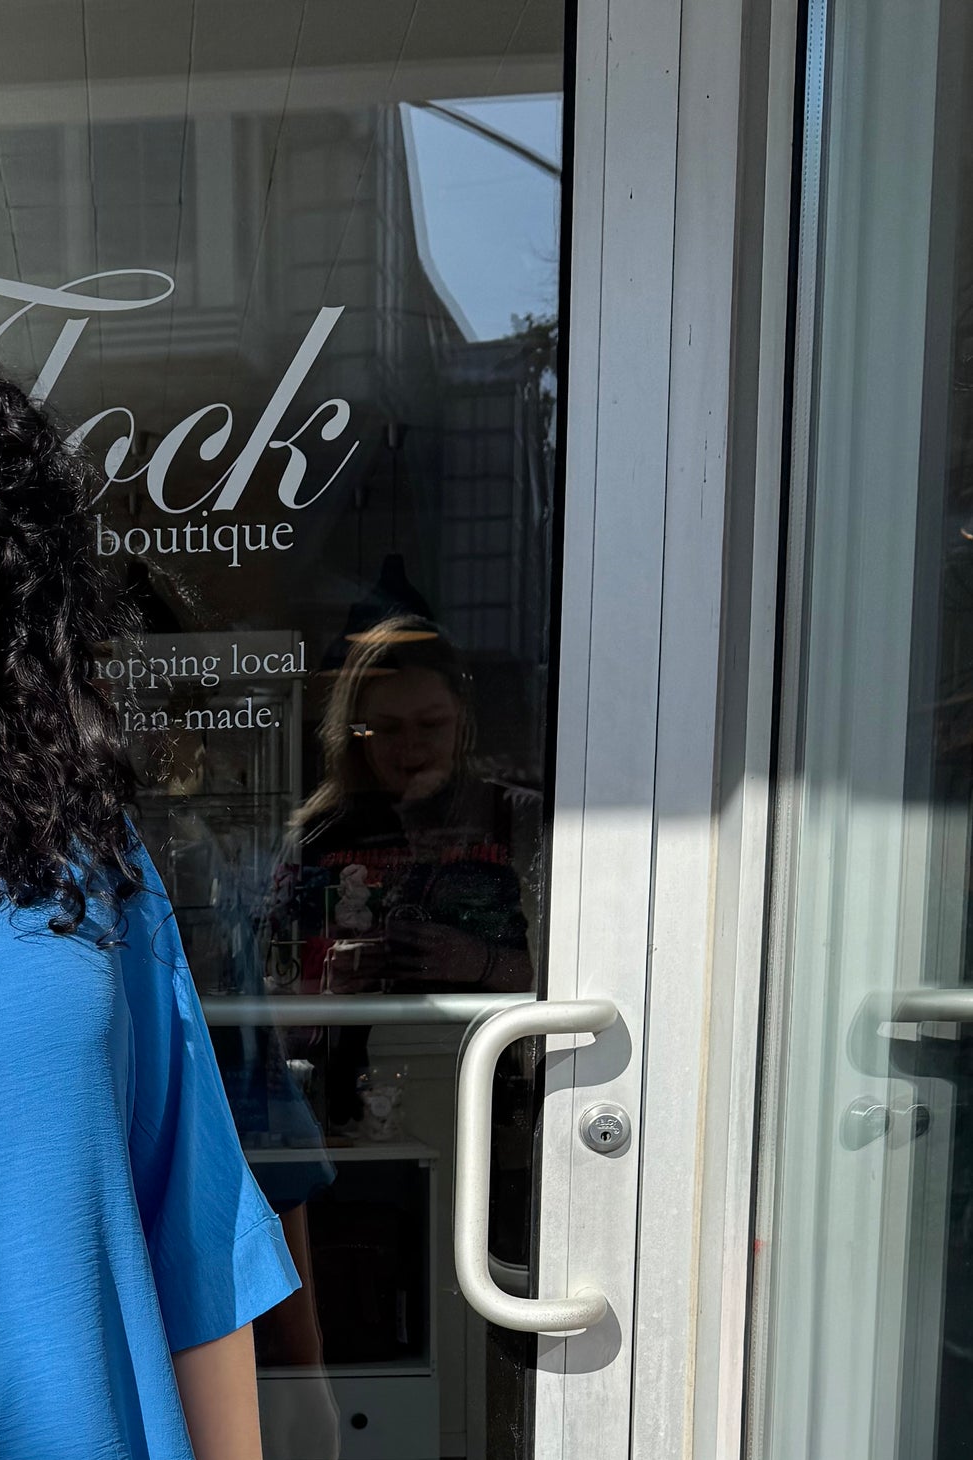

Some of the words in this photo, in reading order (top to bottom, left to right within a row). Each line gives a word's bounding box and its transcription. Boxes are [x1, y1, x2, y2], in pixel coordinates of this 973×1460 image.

[95, 511, 294, 568] boutique
[91, 646, 221, 690] opping
[231, 641, 308, 676] local
[115, 698, 280, 733] ian-made.
